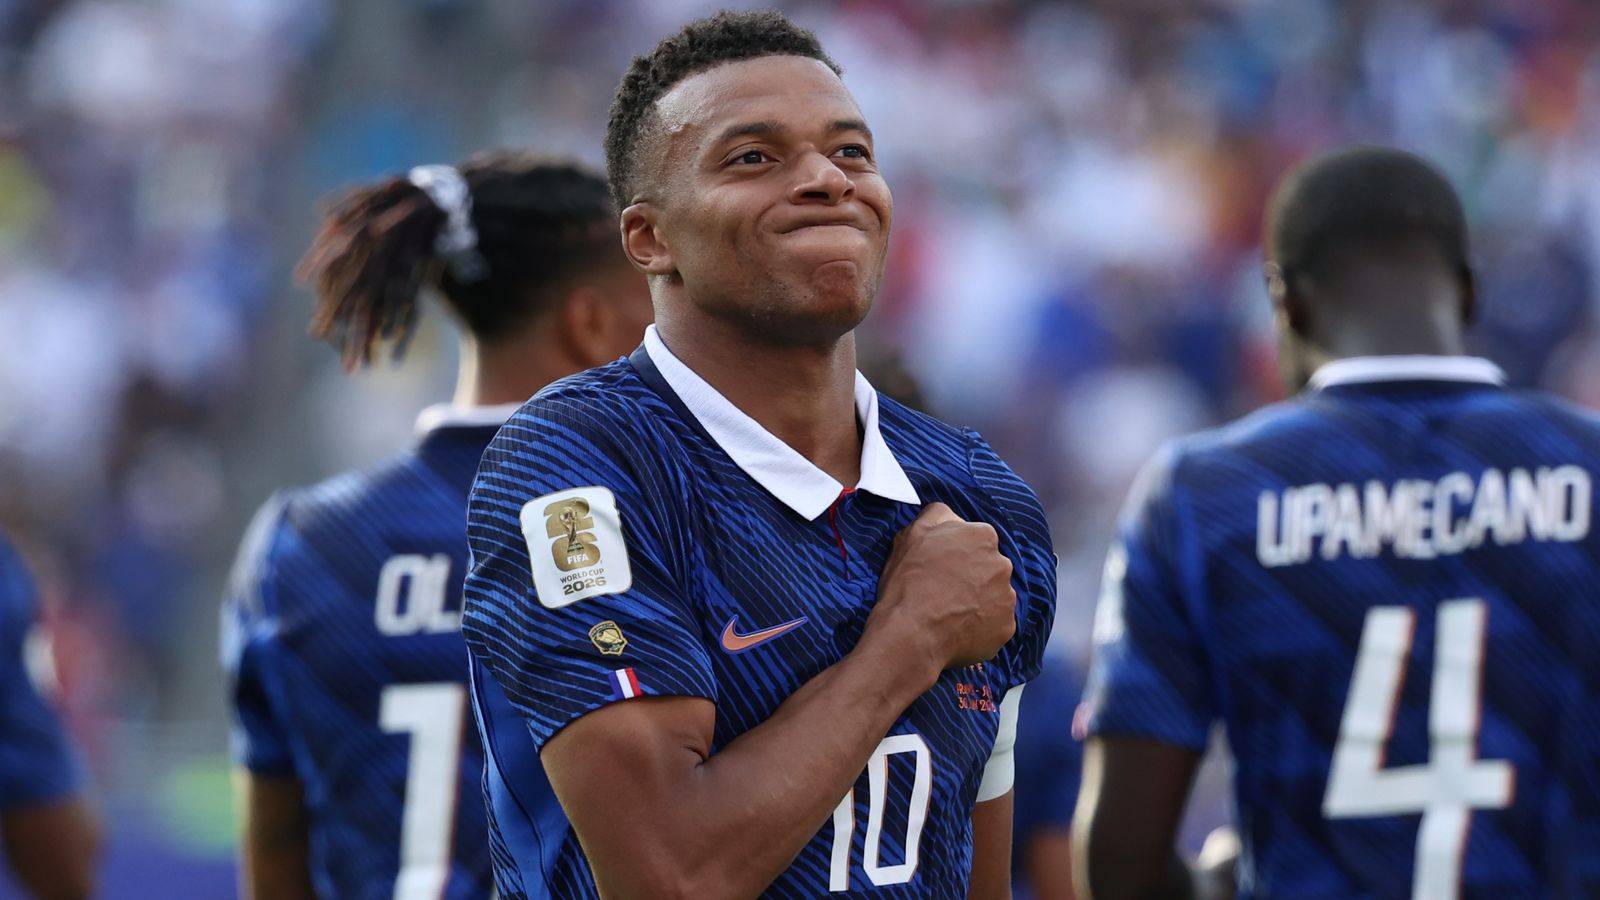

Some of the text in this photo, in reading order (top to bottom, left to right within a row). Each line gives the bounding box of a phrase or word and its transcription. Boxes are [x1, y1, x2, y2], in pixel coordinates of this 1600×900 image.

[1257, 465, 1592, 567] UPAMECANO
[560, 568, 605, 584] WORLD CUP
[563, 577, 607, 595] 2026
[567, 553, 589, 565] FIFA
[1322, 598, 1516, 900] 4
[829, 733, 933, 892] 10
